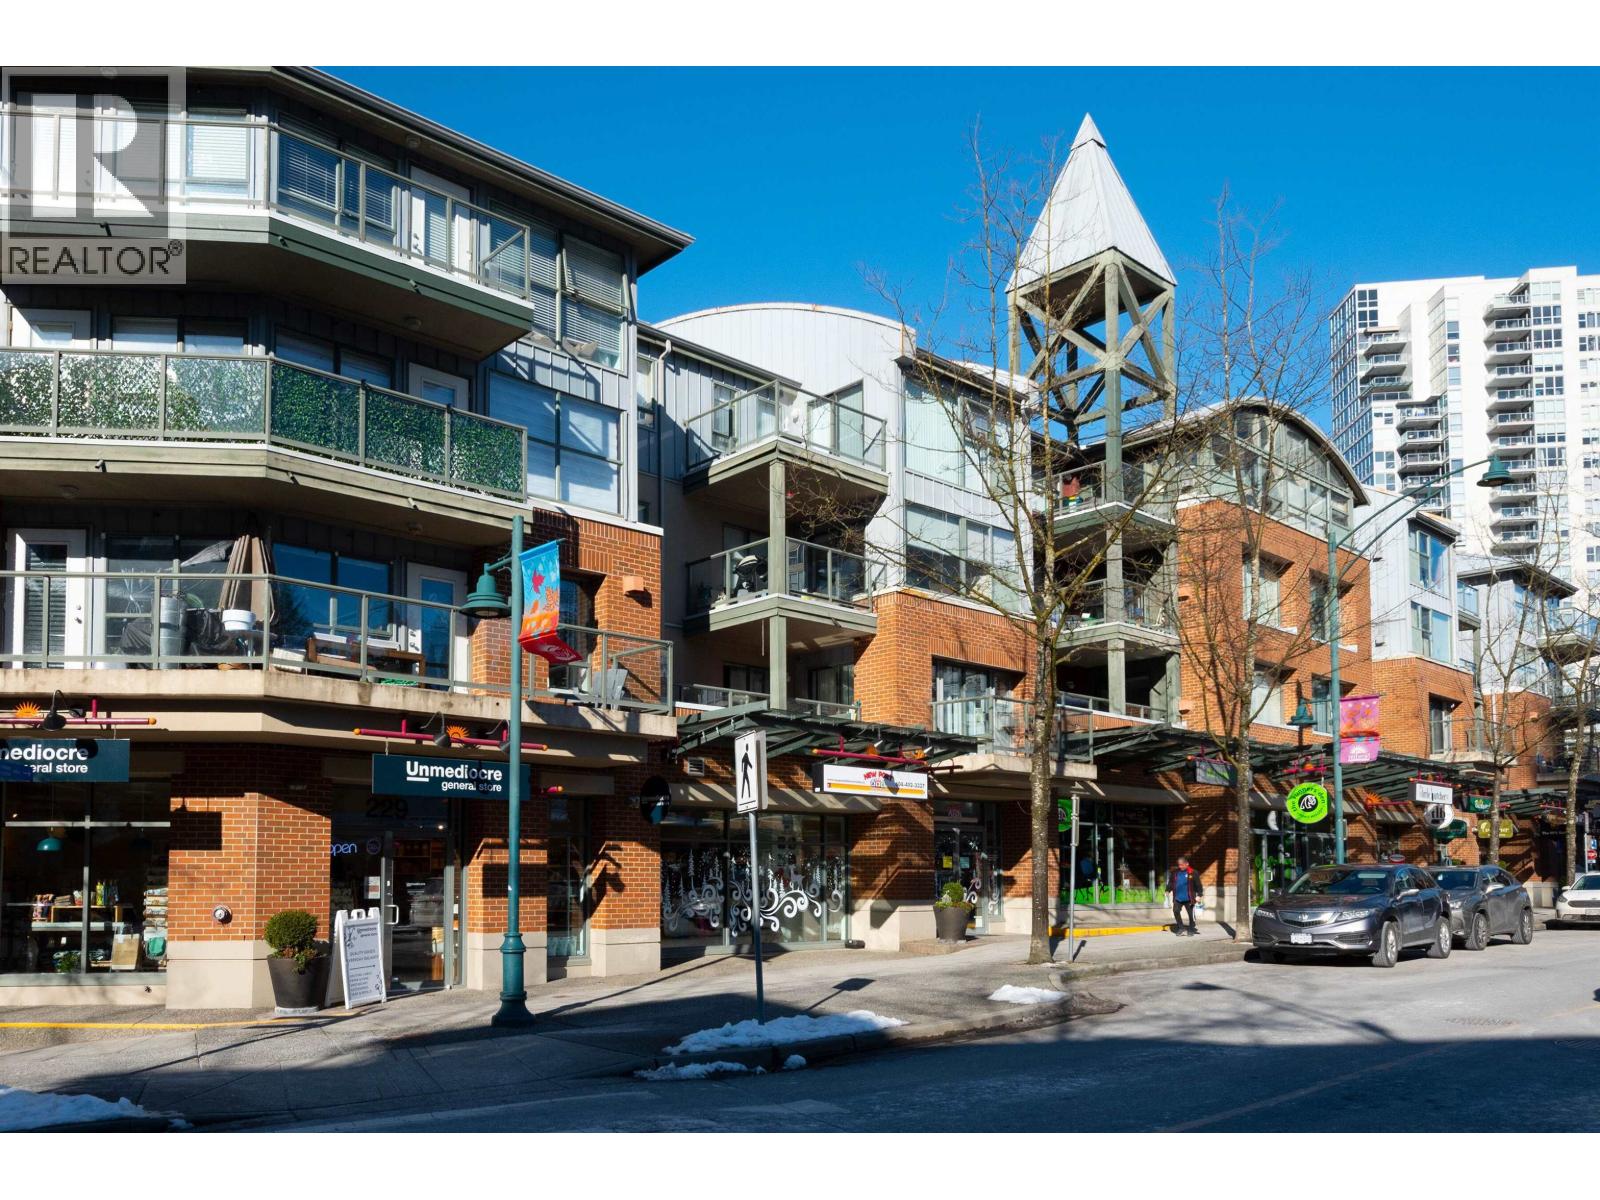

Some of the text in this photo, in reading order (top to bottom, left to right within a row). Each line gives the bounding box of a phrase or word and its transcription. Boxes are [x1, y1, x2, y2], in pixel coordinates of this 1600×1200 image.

[55, 764, 89, 774] store
[406, 760, 503, 781] Unmediocre
[441, 781, 502, 792] general store
[366, 798, 408, 818] 229
